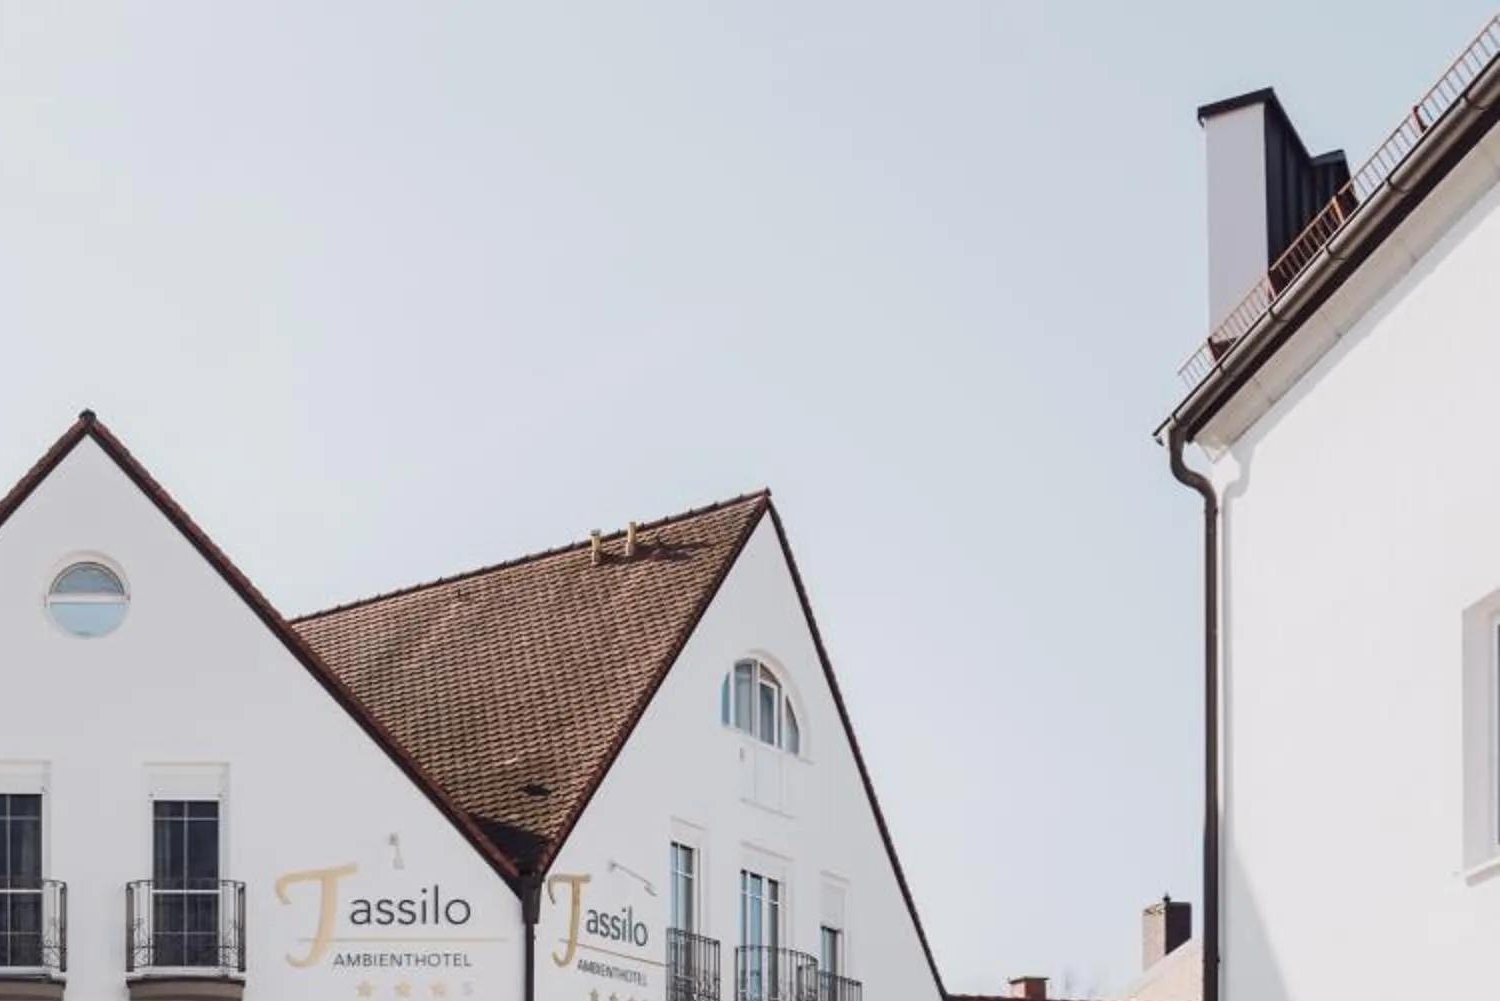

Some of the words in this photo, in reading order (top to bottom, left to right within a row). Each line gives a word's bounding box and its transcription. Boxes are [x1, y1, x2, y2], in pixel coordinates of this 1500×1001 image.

[274, 861, 472, 968] Tassilo
[547, 873, 649, 968] Tassilo
[332, 952, 474, 968] AMBIENTHOTEL
[577, 959, 648, 987] AMBIENTHOTEL
